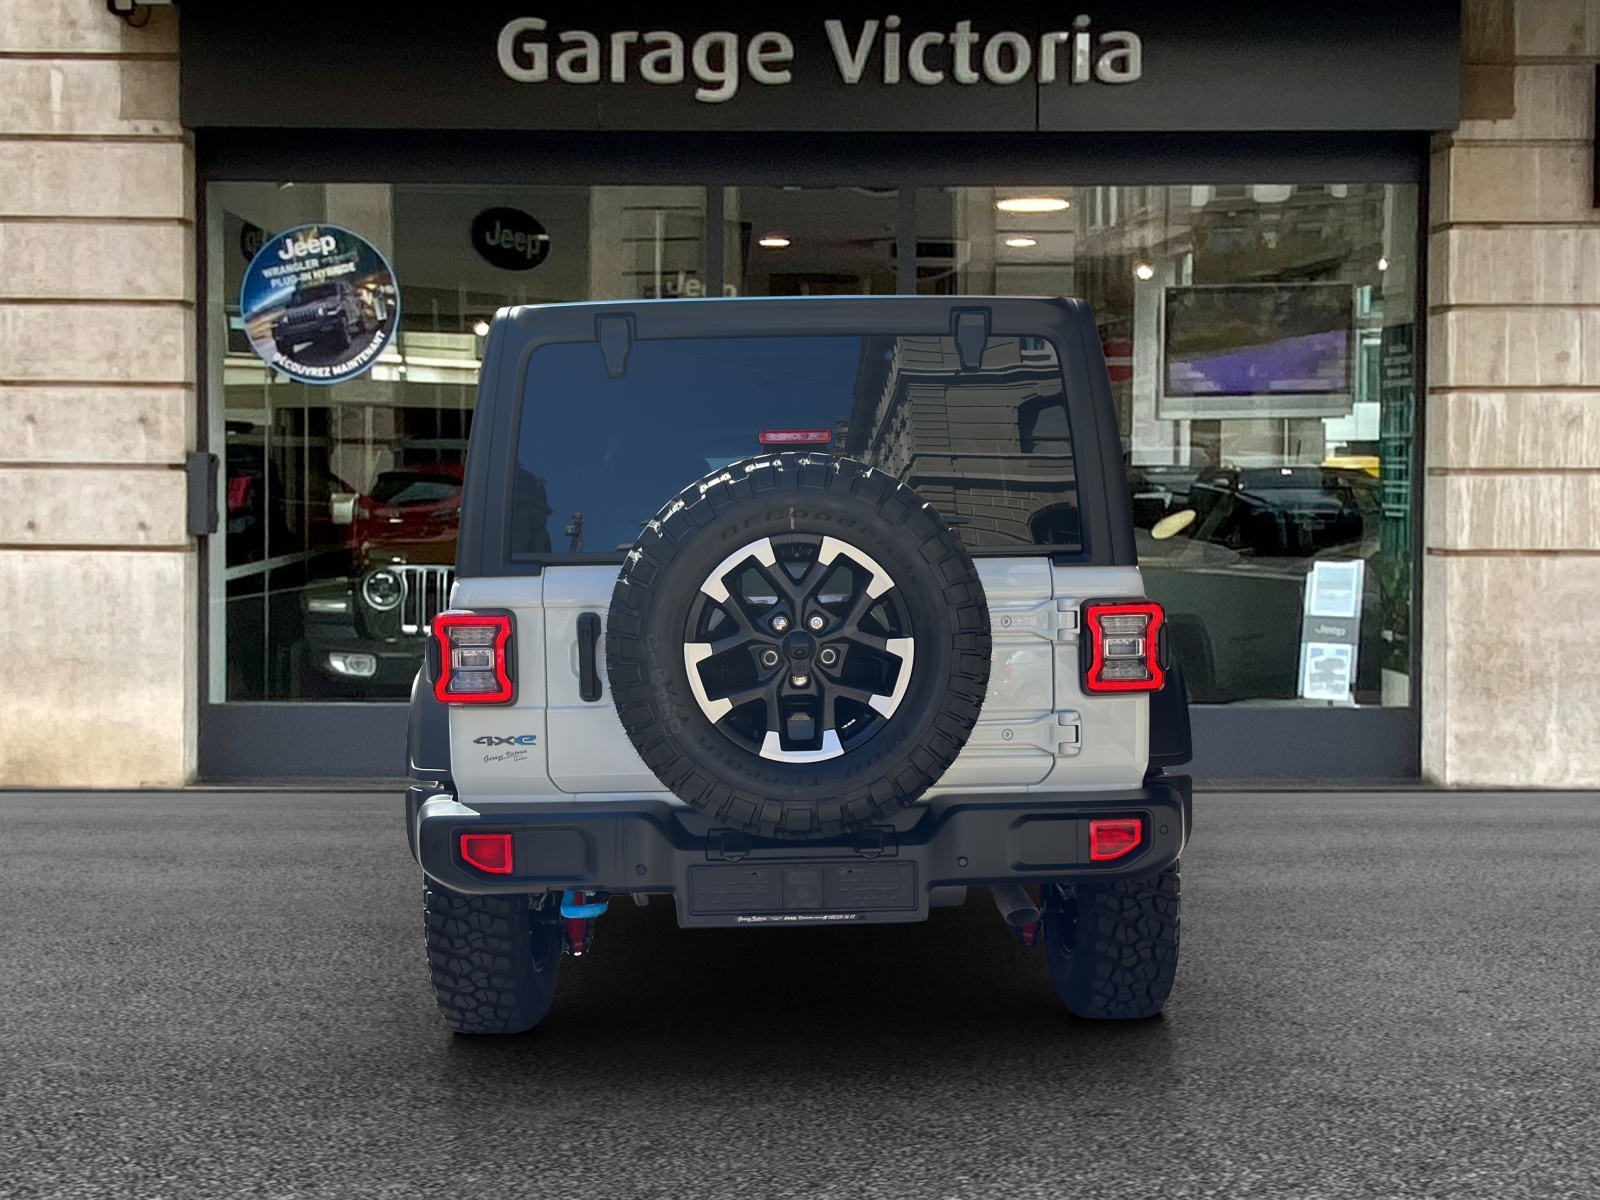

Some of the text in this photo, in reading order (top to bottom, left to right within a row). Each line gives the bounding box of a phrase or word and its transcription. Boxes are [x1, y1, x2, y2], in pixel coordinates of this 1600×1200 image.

[498, 14, 1143, 103] Garage Victoria
[278, 234, 337, 260] Jeep
[485, 219, 541, 259] Jeep
[262, 258, 320, 278] WRANGLER
[332, 329, 386, 376] MAINTENANT
[1314, 623, 1346, 637] Jeep
